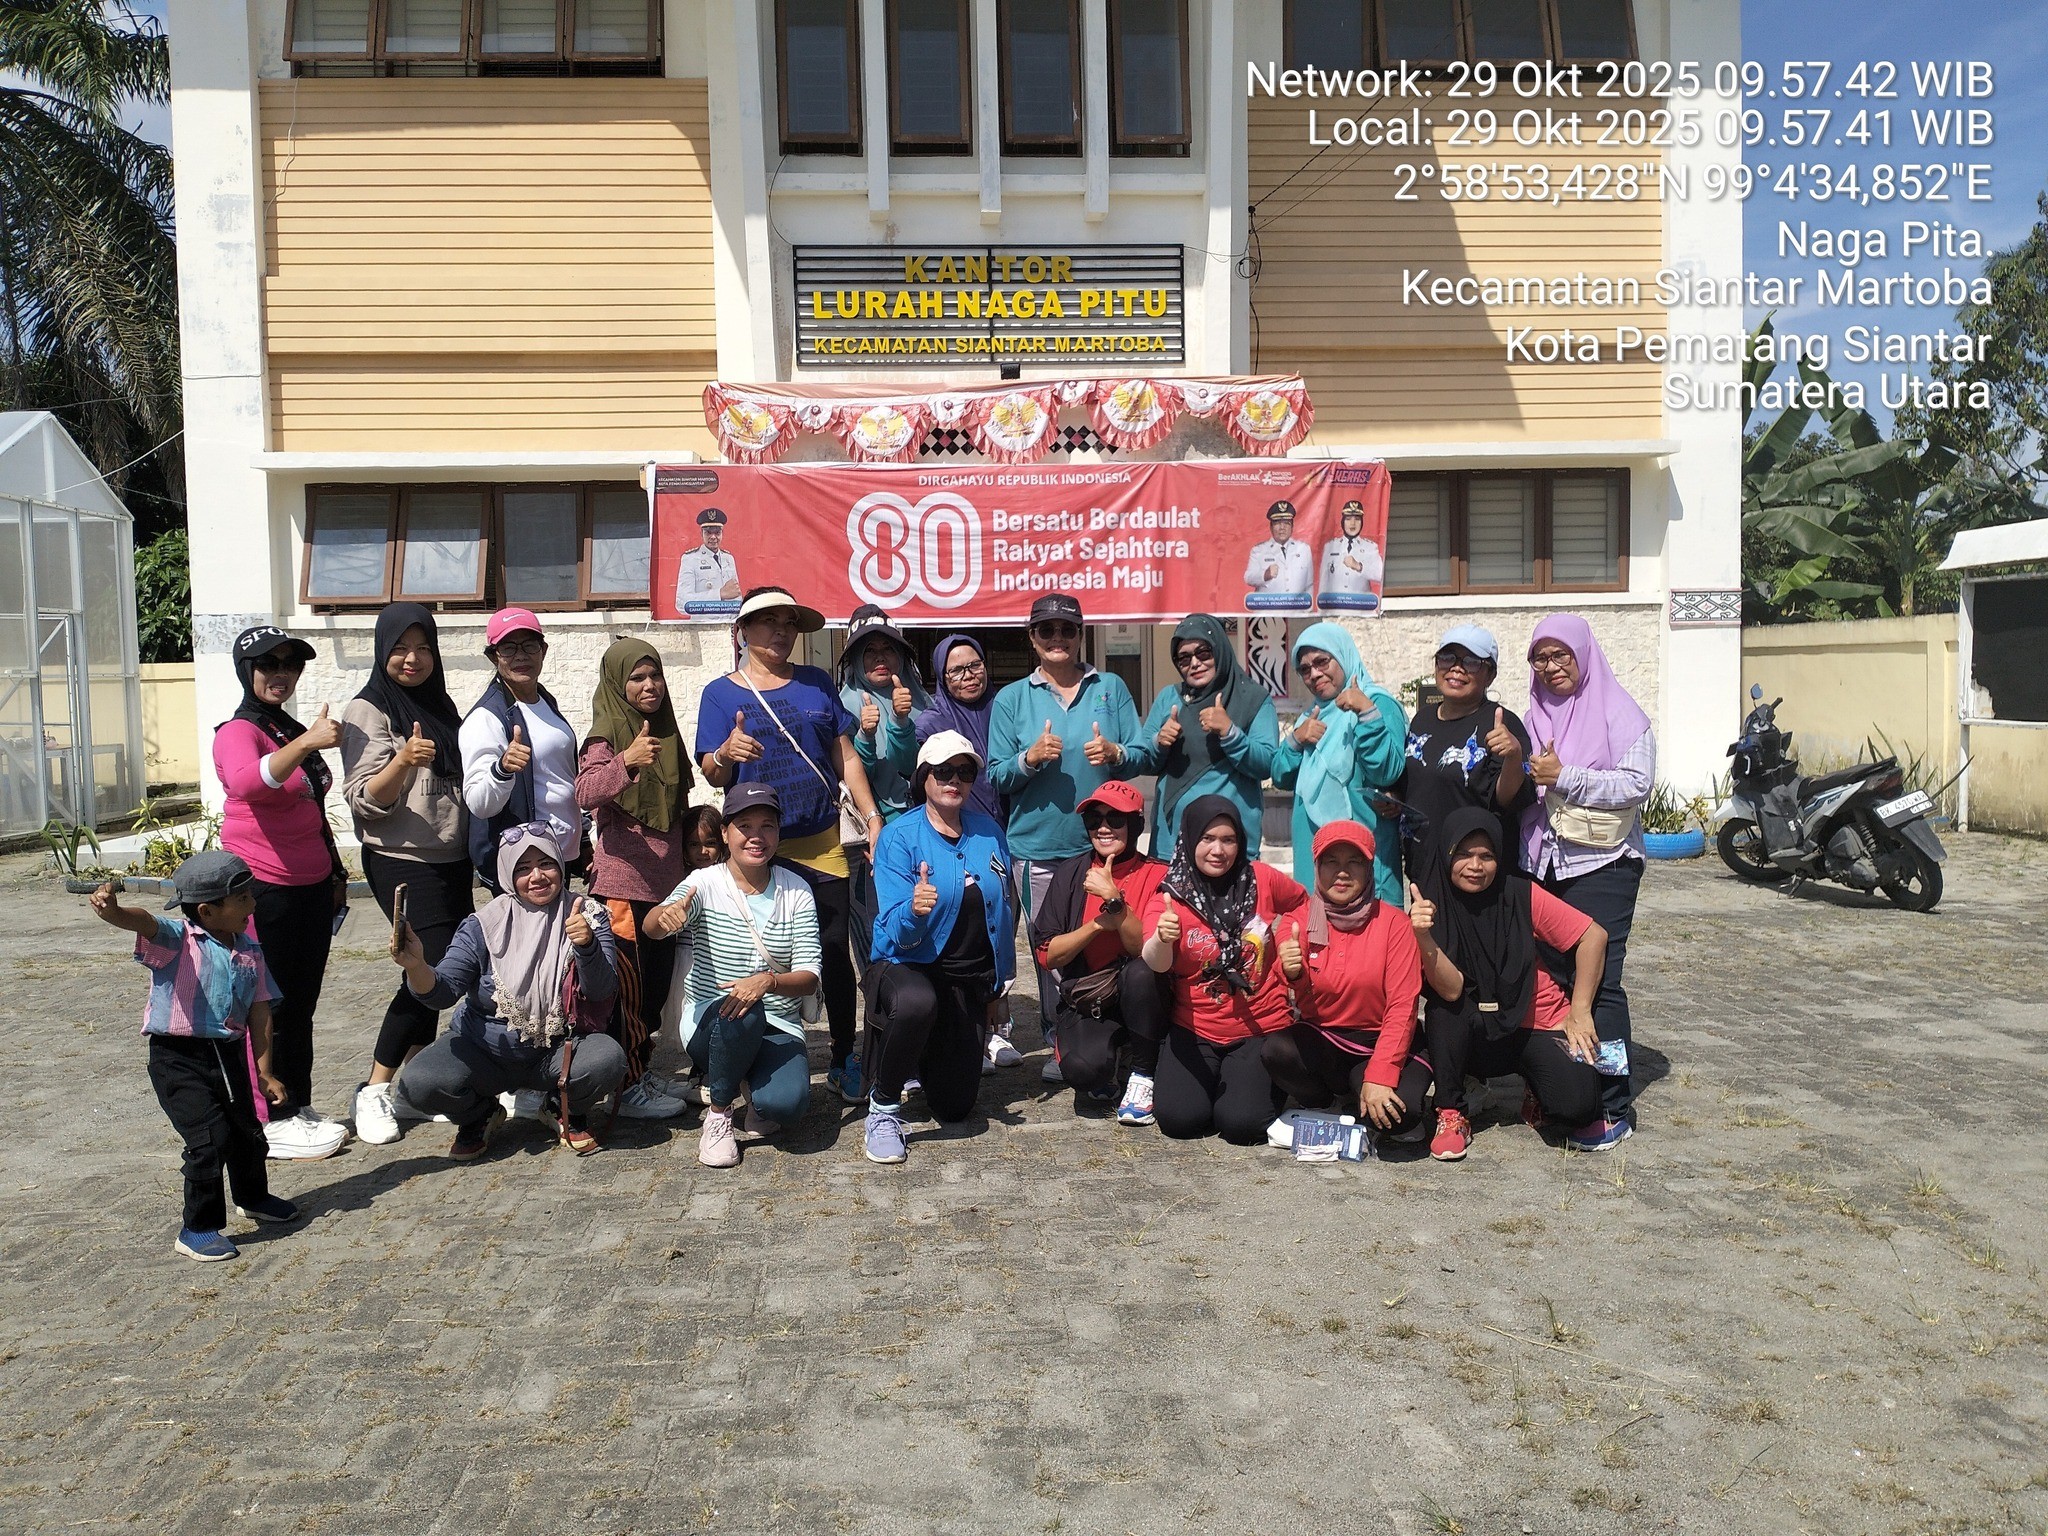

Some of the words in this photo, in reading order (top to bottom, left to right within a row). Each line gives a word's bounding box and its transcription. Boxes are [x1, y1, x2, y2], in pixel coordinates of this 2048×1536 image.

[904, 255, 1075, 284] KANTOR
[813, 290, 944, 319] LURAH
[957, 290, 1065, 318] NAGA
[1080, 289, 1168, 318] PITU
[814, 337, 948, 354] KECAMATAN
[955, 337, 1051, 353] SIANTAR
[1054, 336, 1166, 353] MARTOBA
[918, 474, 995, 487] DIRGAHAYU
[997, 474, 1059, 486] REPUBLIK
[1061, 472, 1132, 485] INDONESIA
[993, 508, 1084, 532] Bersatu
[1090, 505, 1201, 531] Berdaulat
[847, 491, 983, 610] 80
[993, 540, 1074, 567] Rakyat
[1079, 537, 1189, 562] Sejahtera
[994, 568, 1103, 592] Indonesia
[1112, 565, 1163, 593] Maju
[240, 627, 290, 651] SPO
[1101, 783, 1139, 800] ORT
